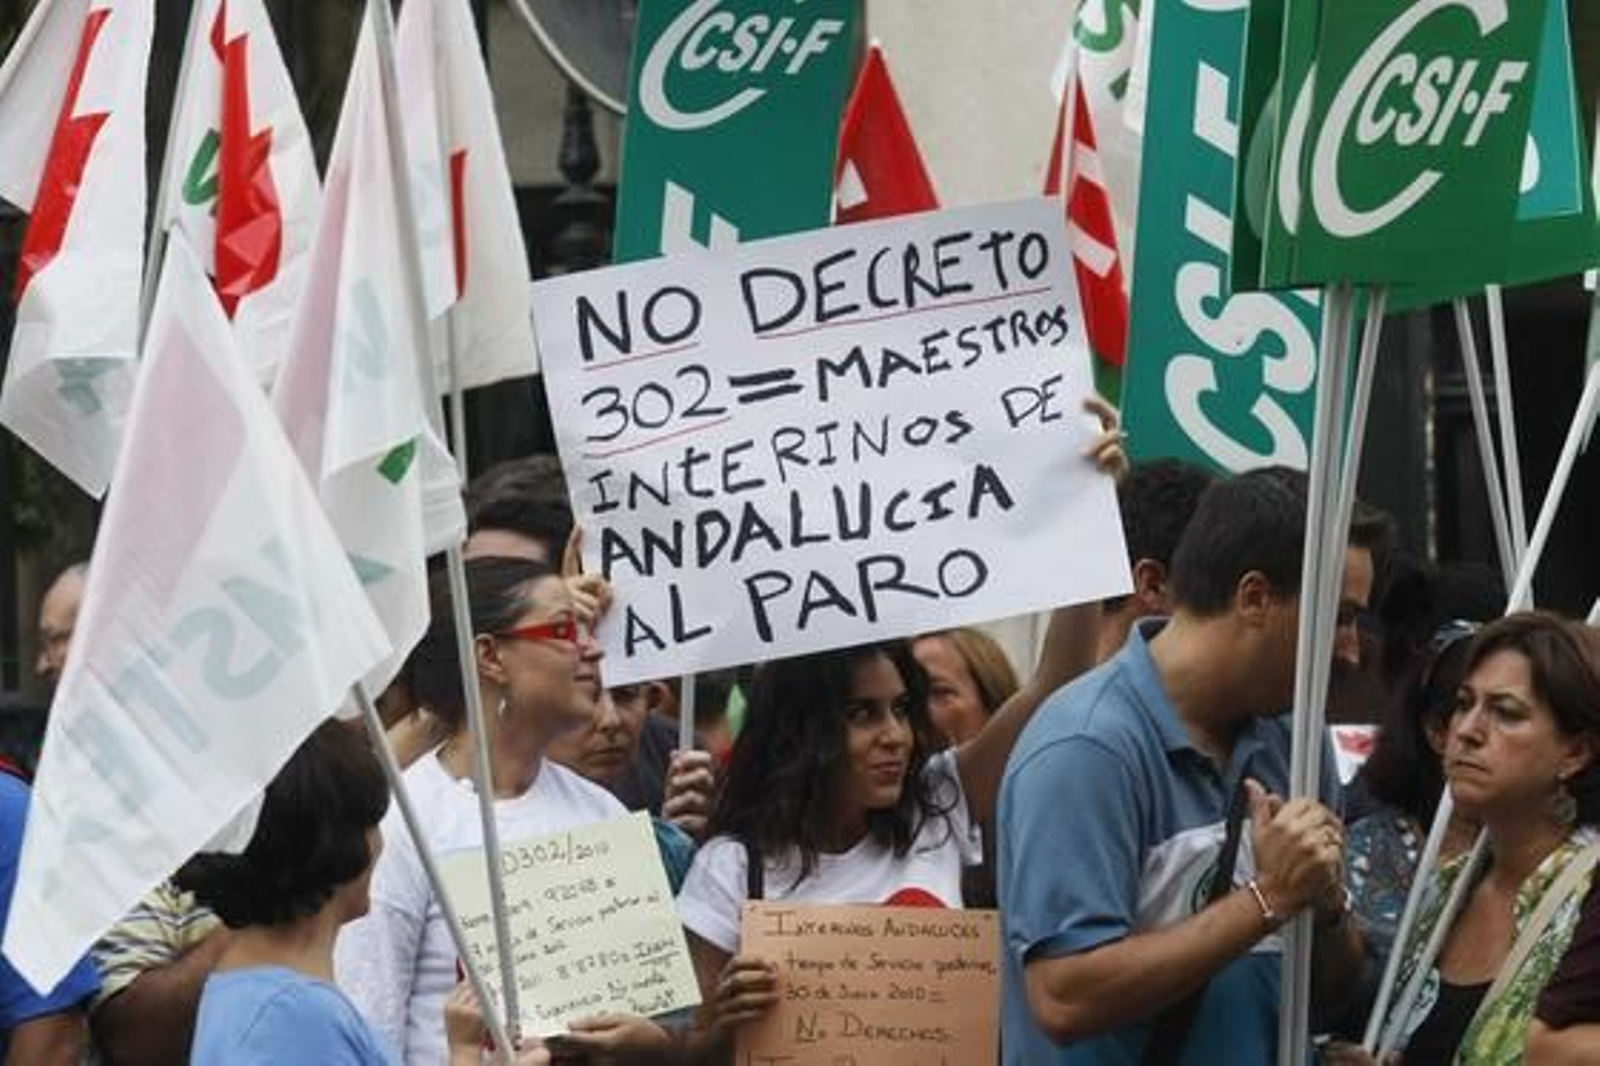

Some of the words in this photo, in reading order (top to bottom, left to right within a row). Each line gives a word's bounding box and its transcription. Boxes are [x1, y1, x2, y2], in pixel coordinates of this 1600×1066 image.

[576, 286, 701, 361] NO
[741, 231, 1049, 334] DECRETO
[817, 304, 1068, 401] MAESTROS
[1000, 374, 1064, 428] DE
[601, 464, 1015, 580] ANDALUCIA
[624, 584, 712, 657] AL
[745, 549, 989, 643] PARO
